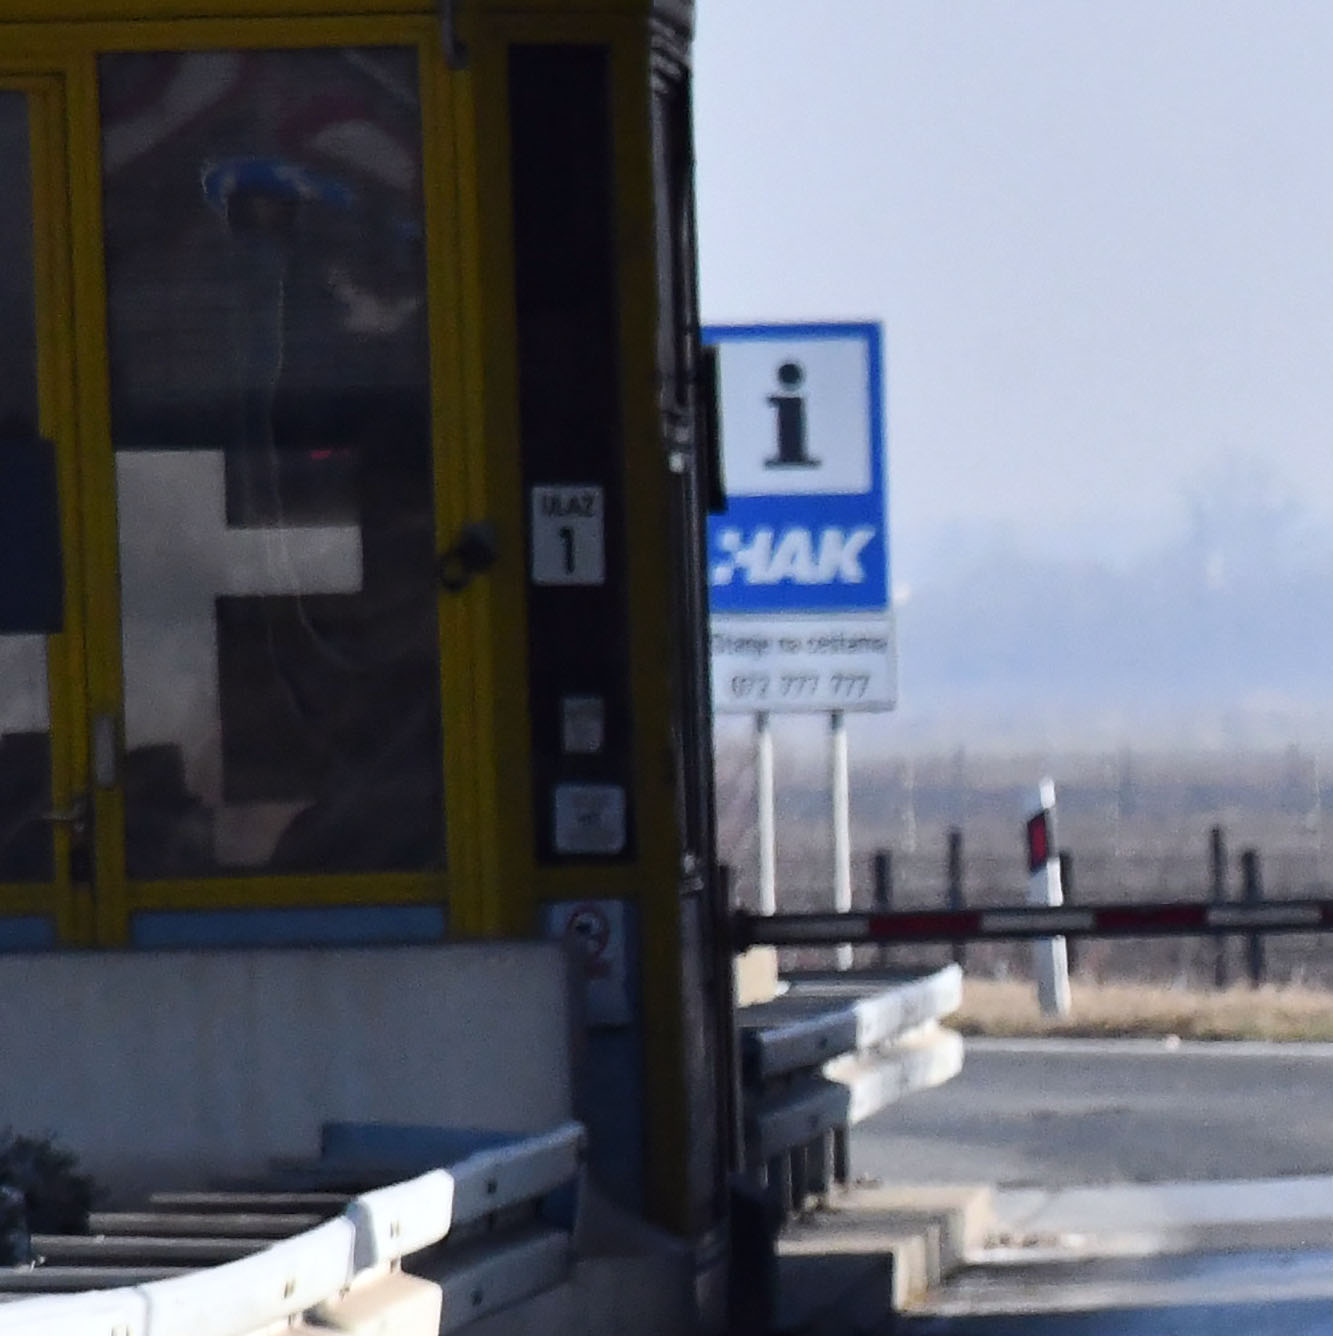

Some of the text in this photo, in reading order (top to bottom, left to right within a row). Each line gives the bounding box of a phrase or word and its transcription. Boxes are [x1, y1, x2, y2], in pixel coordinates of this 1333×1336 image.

[559, 527, 577, 574] 1
[712, 527, 876, 585] HAK
[830, 674, 872, 698] 777
